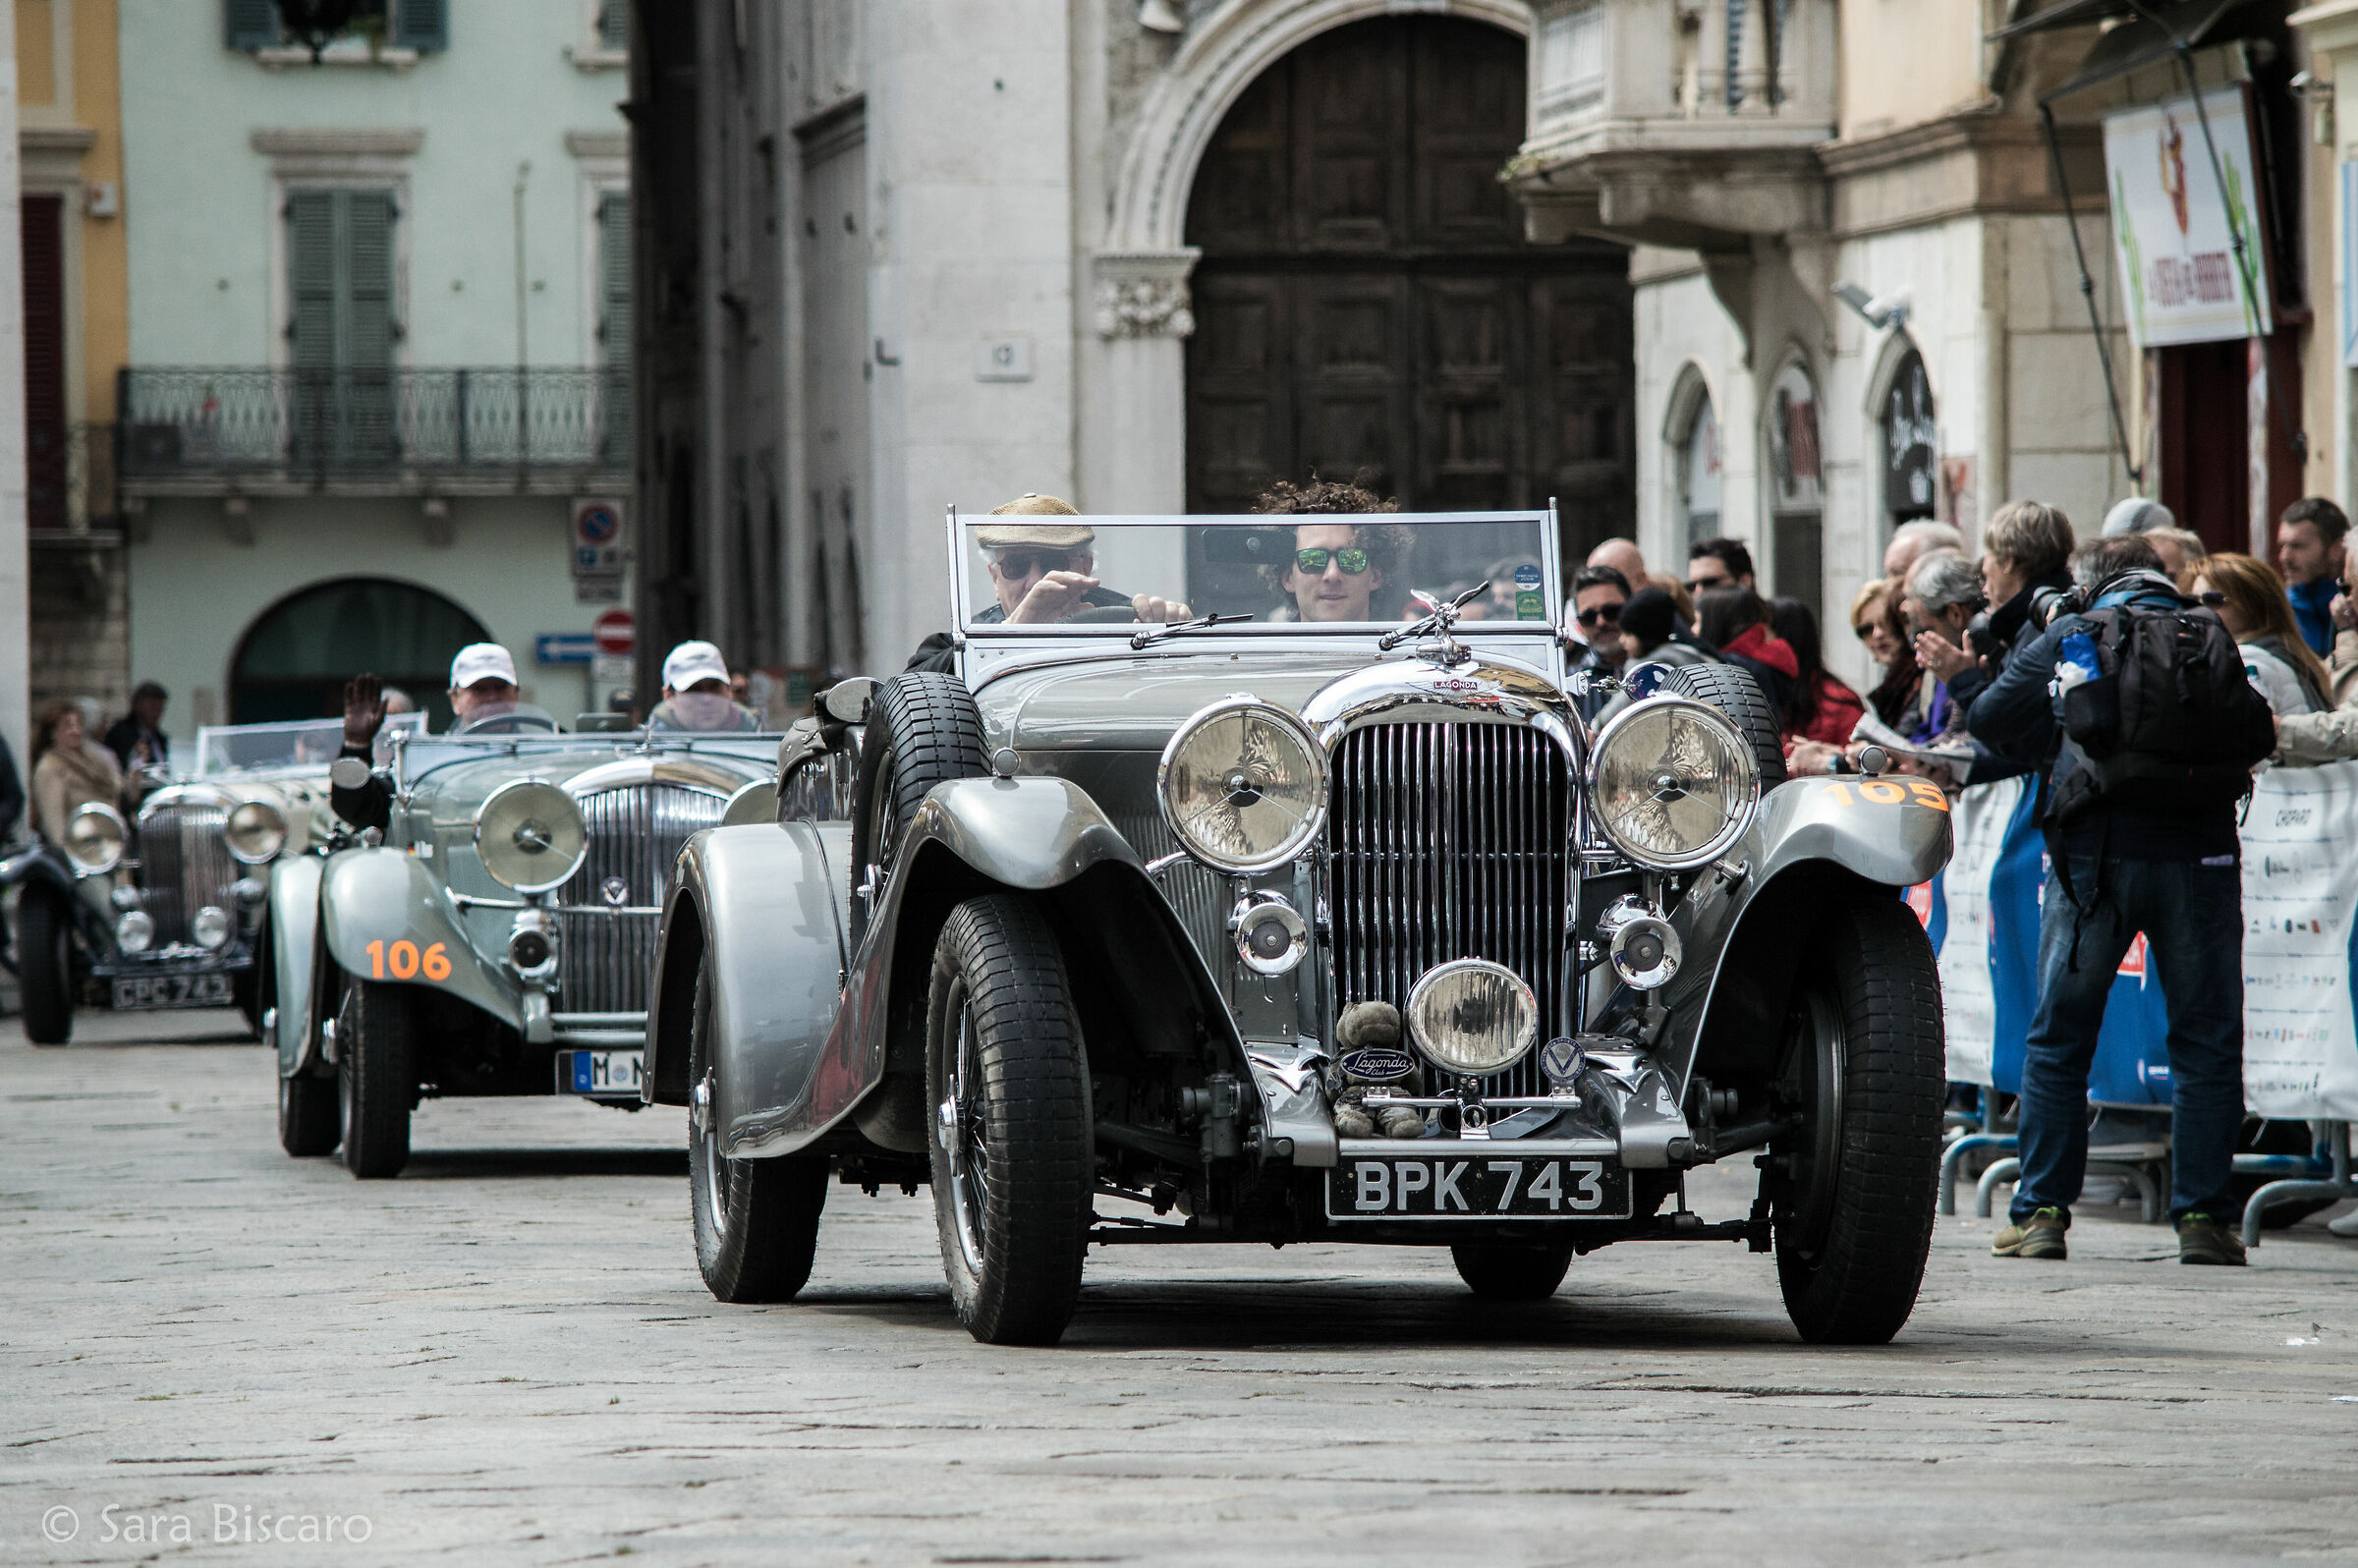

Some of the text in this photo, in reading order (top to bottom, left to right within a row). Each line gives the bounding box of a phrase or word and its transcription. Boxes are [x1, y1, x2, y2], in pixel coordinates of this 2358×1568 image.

[1434, 681, 1477, 690] LAGONDA
[1823, 781, 1949, 812] 105
[365, 939, 452, 980] 106
[593, 1056, 609, 1085] M
[1348, 1052, 1409, 1074] Lagonda
[1355, 1161, 1602, 1210] BPK 743
